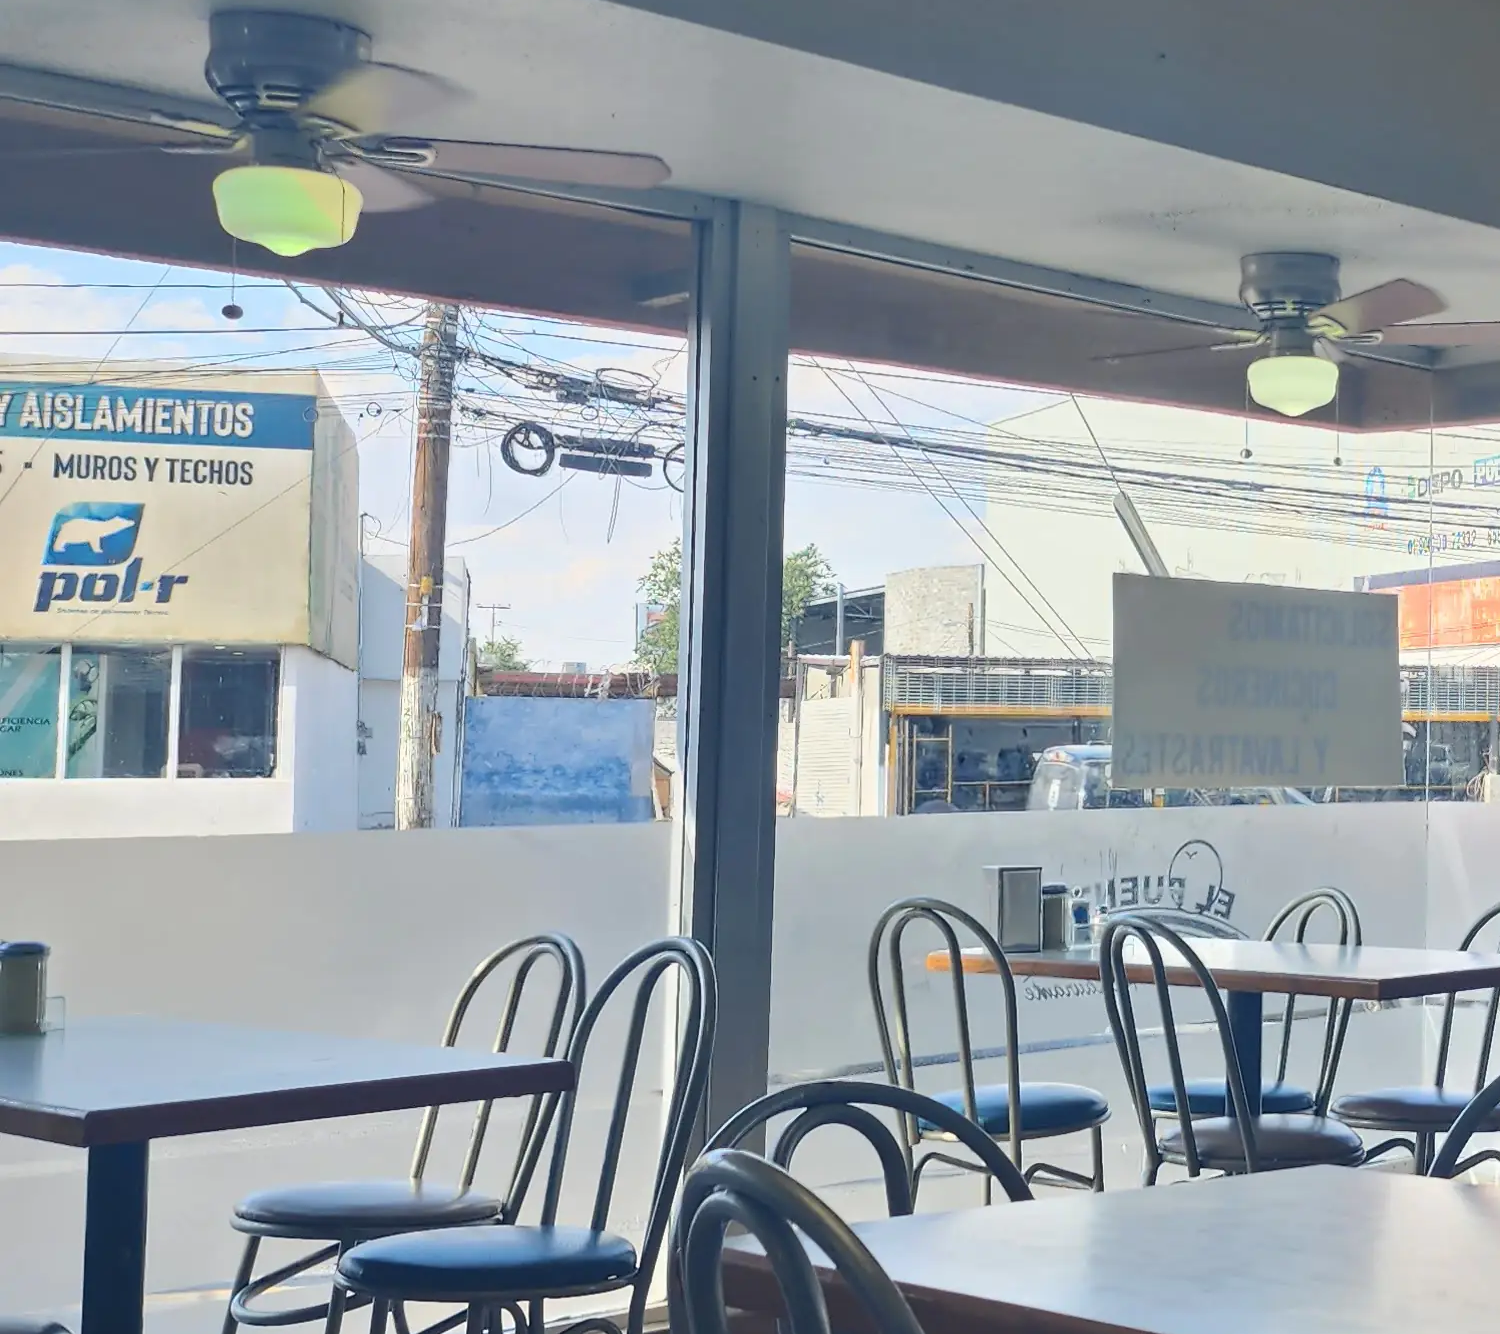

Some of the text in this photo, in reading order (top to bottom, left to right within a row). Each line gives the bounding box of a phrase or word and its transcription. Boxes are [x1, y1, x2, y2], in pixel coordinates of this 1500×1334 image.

[18, 391, 255, 439] AISLAMIENTOS
[53, 452, 254, 486] MUROS Y TECHOS
